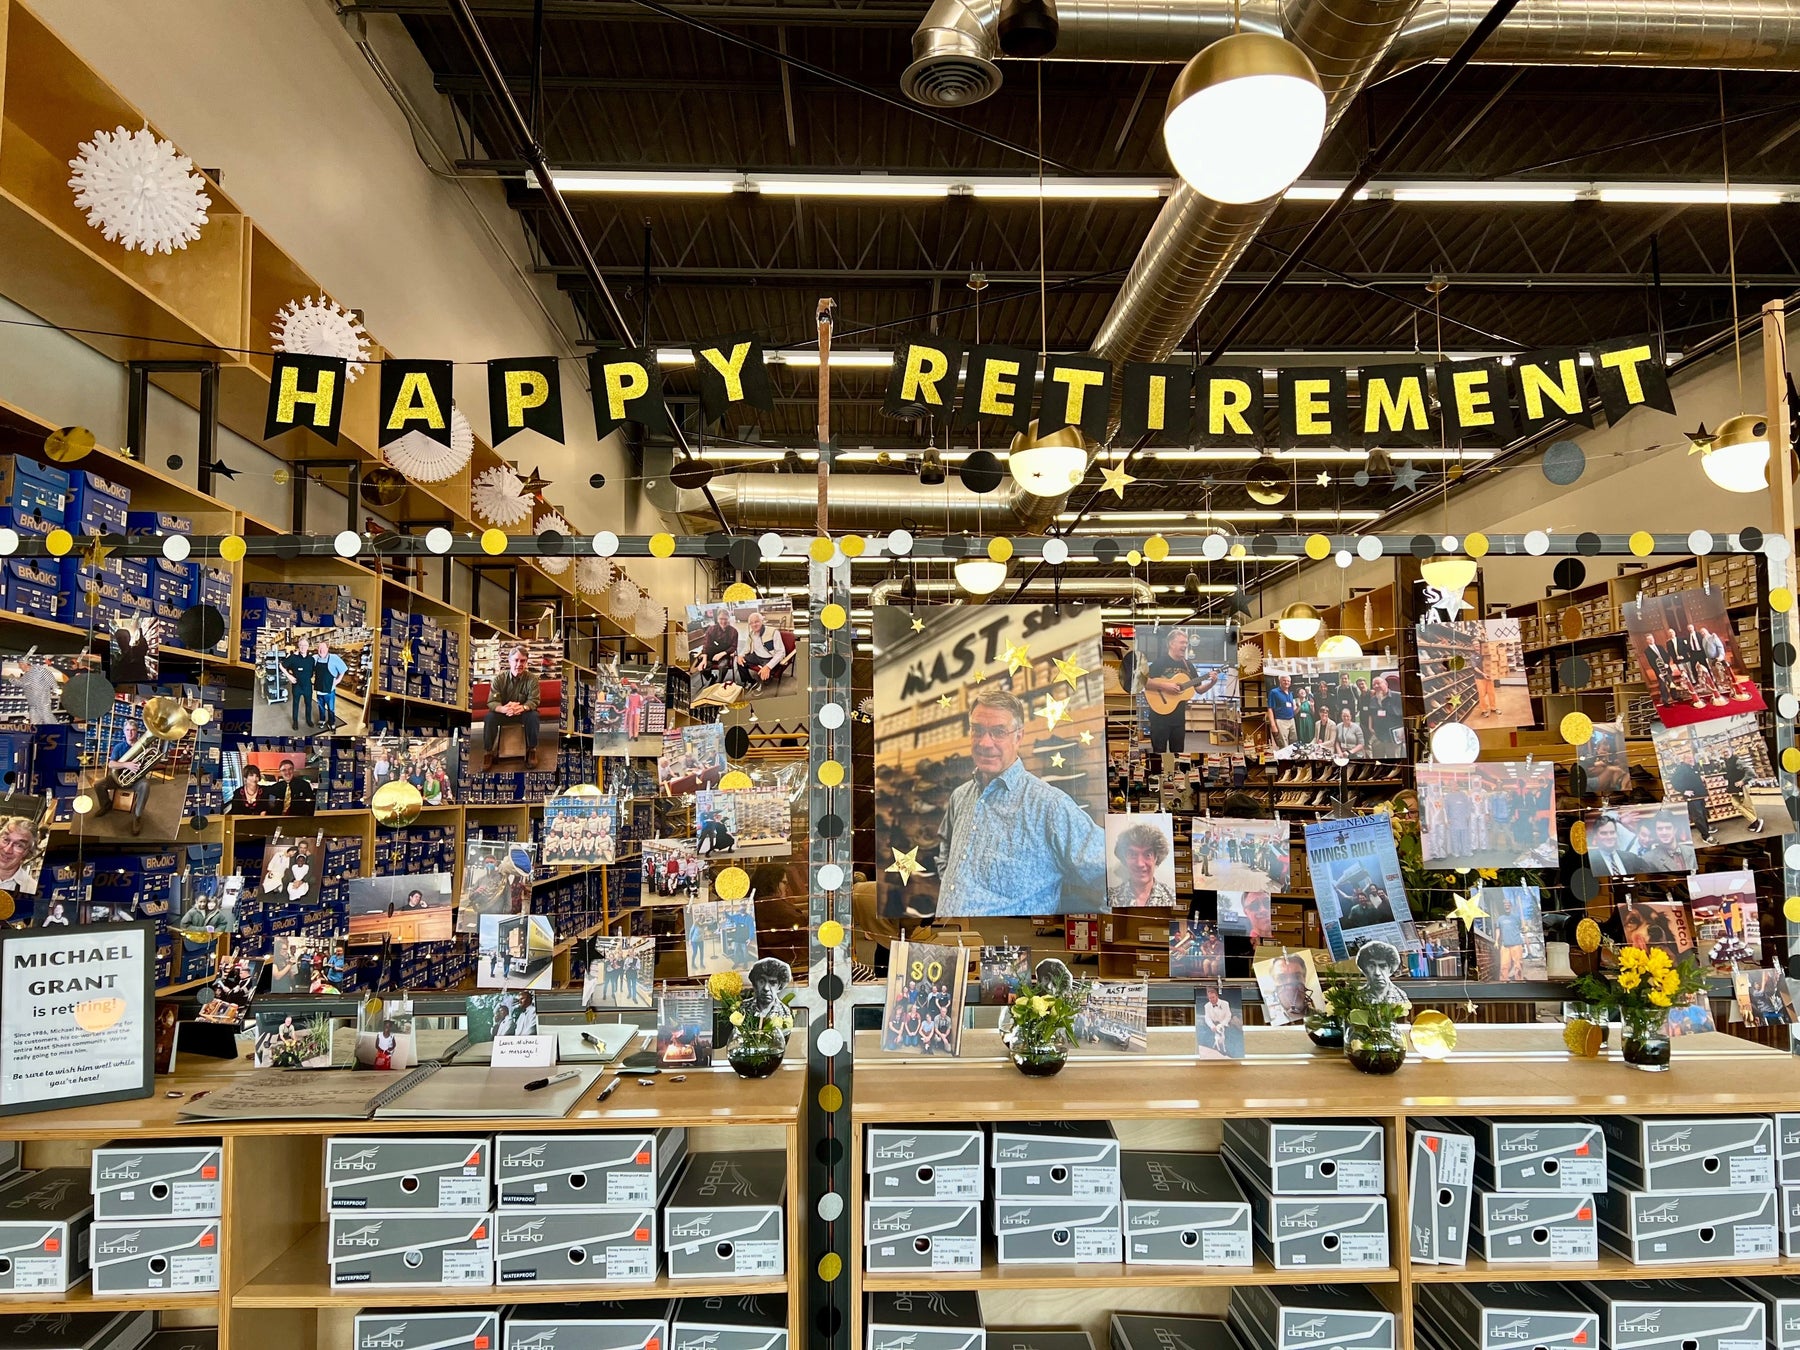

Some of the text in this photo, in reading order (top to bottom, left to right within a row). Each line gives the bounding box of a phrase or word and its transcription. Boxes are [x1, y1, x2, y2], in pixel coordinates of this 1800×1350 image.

[276, 341, 1653, 435] HAPPY RETIREMENT
[901, 615, 1009, 700] MAST
[1346, 815, 1376, 828] NEWS
[1310, 840, 1377, 864] WINGS RULE
[1672, 910, 1688, 946] petco
[14, 945, 133, 969] MICHAEL
[28, 973, 119, 996] GRANT
[33, 998, 117, 1018] is retiring!
[13, 1053, 31, 1061] really
[32, 1052, 49, 1061] going
[25, 1071, 44, 1079] sure
[55, 1066, 76, 1075] wish
[76, 1064, 93, 1072] him
[94, 1061, 112, 1069] well
[49, 1073, 100, 1088] you're here!
[876, 1145, 915, 1159] dansko
[1278, 1140, 1316, 1154] dansko
[1501, 1138, 1538, 1151] dansko
[1651, 1138, 1692, 1153] dansko
[502, 1153, 545, 1168] dansko
[1000, 1147, 1028, 1159] dansko
[333, 1156, 377, 1171] dansko
[100, 1165, 141, 1180] dansko
[332, 1199, 367, 1208] WATERPROOF
[503, 1195, 536, 1203] WATERPROOF
[1002, 1213, 1032, 1226] dansko
[1131, 1214, 1160, 1227] dansko
[1279, 1214, 1319, 1229] dansko
[1491, 1209, 1529, 1222] dansko
[1639, 1209, 1679, 1224] dansko
[672, 1224, 712, 1238] dansko
[873, 1216, 911, 1232] dansko
[337, 1231, 380, 1247] dansko
[501, 1228, 545, 1244] dansko
[98, 1239, 139, 1255] dansko
[336, 1273, 371, 1283] WATERPROOF
[503, 1271, 537, 1280] WATERPROOF
[1288, 1324, 1326, 1340] dansko
[1490, 1325, 1529, 1340] dansko
[1618, 1318, 1660, 1334] dansko
[361, 1333, 405, 1349] dansko
